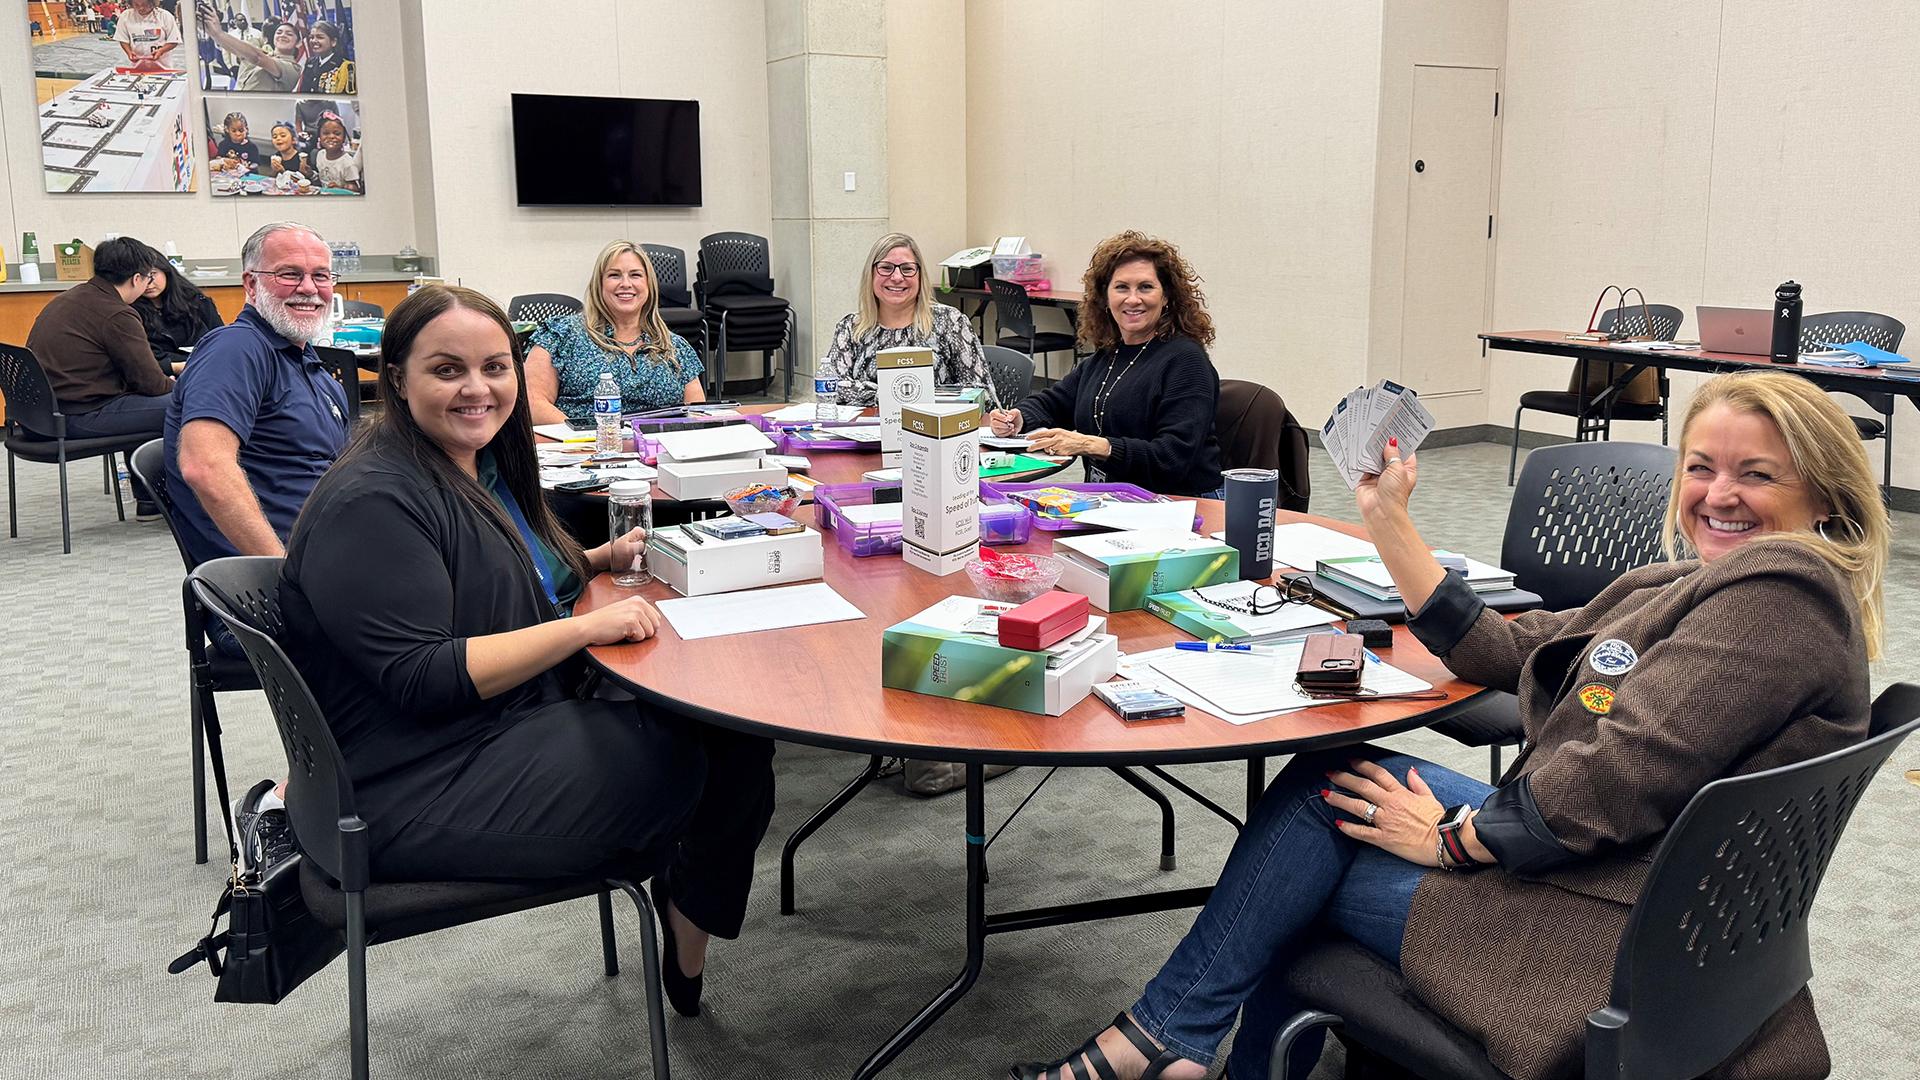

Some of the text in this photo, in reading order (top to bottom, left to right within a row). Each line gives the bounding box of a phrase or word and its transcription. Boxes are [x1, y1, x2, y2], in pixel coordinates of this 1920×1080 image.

[912, 420, 925, 431] FCSS
[958, 419, 971, 430] FCSS
[945, 501, 964, 515] Speed
[1258, 498, 1273, 529] DAD
[1256, 532, 1271, 562] UCD
[932, 652, 940, 684] SPEED
[940, 655, 948, 683] TRUST
